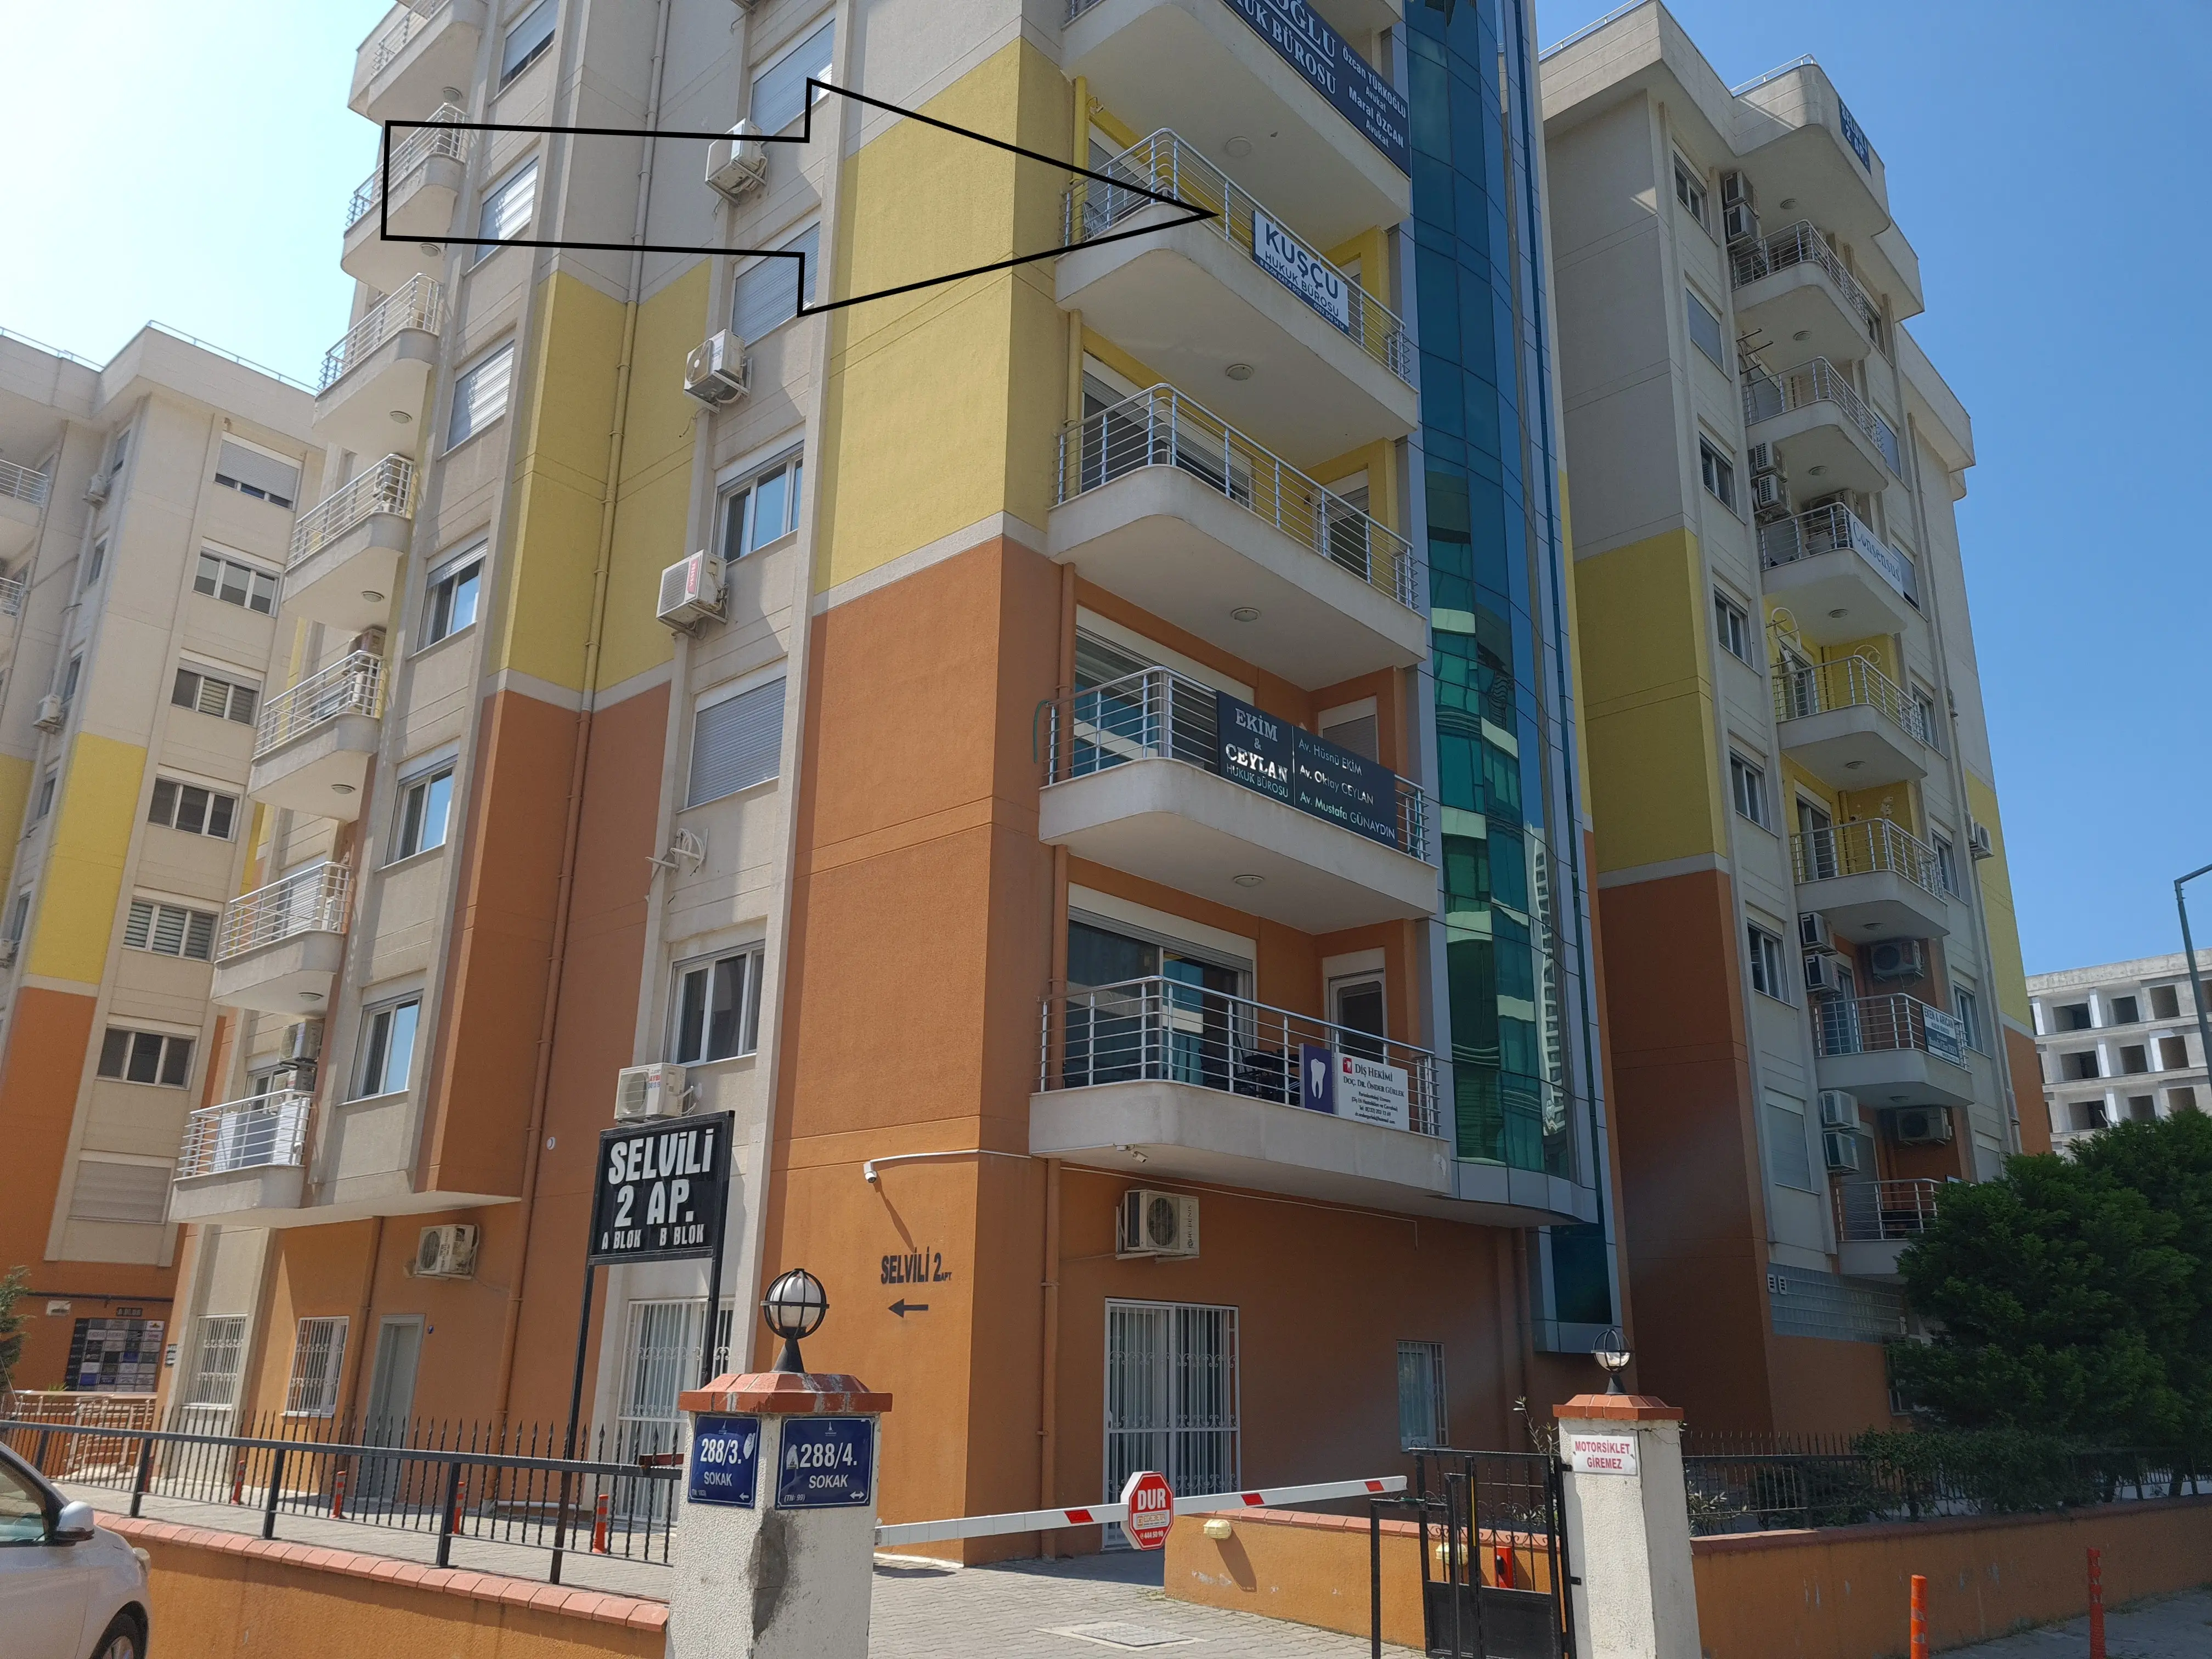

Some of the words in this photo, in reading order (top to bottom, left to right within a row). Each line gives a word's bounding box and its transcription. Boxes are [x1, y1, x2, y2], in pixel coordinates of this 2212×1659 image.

[1271, 17, 1336, 94] BÜROSU
[1342, 46, 1366, 79] Özcan
[1367, 72, 1406, 119] TÜRKOĞLU
[1365, 86, 1387, 113] Avukat
[1348, 86, 1374, 120] Maral
[1376, 111, 1404, 148] ÖZCAN
[1365, 119, 1389, 148] Avukat
[1265, 264, 1278, 279] BLOK
[1266, 223, 1338, 299] KUŞÇU
[1265, 251, 1299, 285] HUKUK
[1301, 280, 1339, 317] BÜROSU
[1853, 521, 1900, 582] Consensus
[1234, 708, 1278, 742] EKİM
[1254, 737, 1262, 751] &
[1298, 738, 1311, 753] Av.
[1313, 744, 1340, 765] Hüsnü
[1342, 757, 1362, 776] EKİM
[1225, 742, 1288, 784] CEYLAN
[1226, 763, 1255, 786] HUKUK
[1256, 774, 1289, 798] BÜROSU
[1299, 764, 1312, 779] Av.
[1314, 770, 1339, 793] Oktay
[1341, 783, 1374, 806] CEYLAN
[1300, 791, 1312, 805] Av.
[1314, 797, 1347, 820] Mustafa
[1350, 812, 1396, 840] GÜNAYDIN
[1367, 1081, 1385, 1093] ÖNDER
[1385, 1085, 1404, 1097] GÜRLEK
[614, 1184, 634, 1228] 2
[646, 1178, 695, 1225] AP.
[601, 1232, 608, 1250] A
[613, 1229, 642, 1250] BLOK
[659, 1227, 668, 1246] B
[673, 1223, 705, 1245] BLOK
[881, 1246, 930, 1285] SELVİLİ
[933, 1252, 942, 1282] 2
[699, 1437, 741, 1466] 288/3.
[799, 1442, 857, 1469] 288/4.
[1575, 1440, 1630, 1455] MOTORSİKLET
[1587, 1454, 1623, 1470] GİREMEZ
[704, 1471, 732, 1487] SOKAK
[808, 1474, 849, 1489] SOKAK
[796, 1494, 806, 1502] 99)
[1137, 1487, 1166, 1511] DUR
